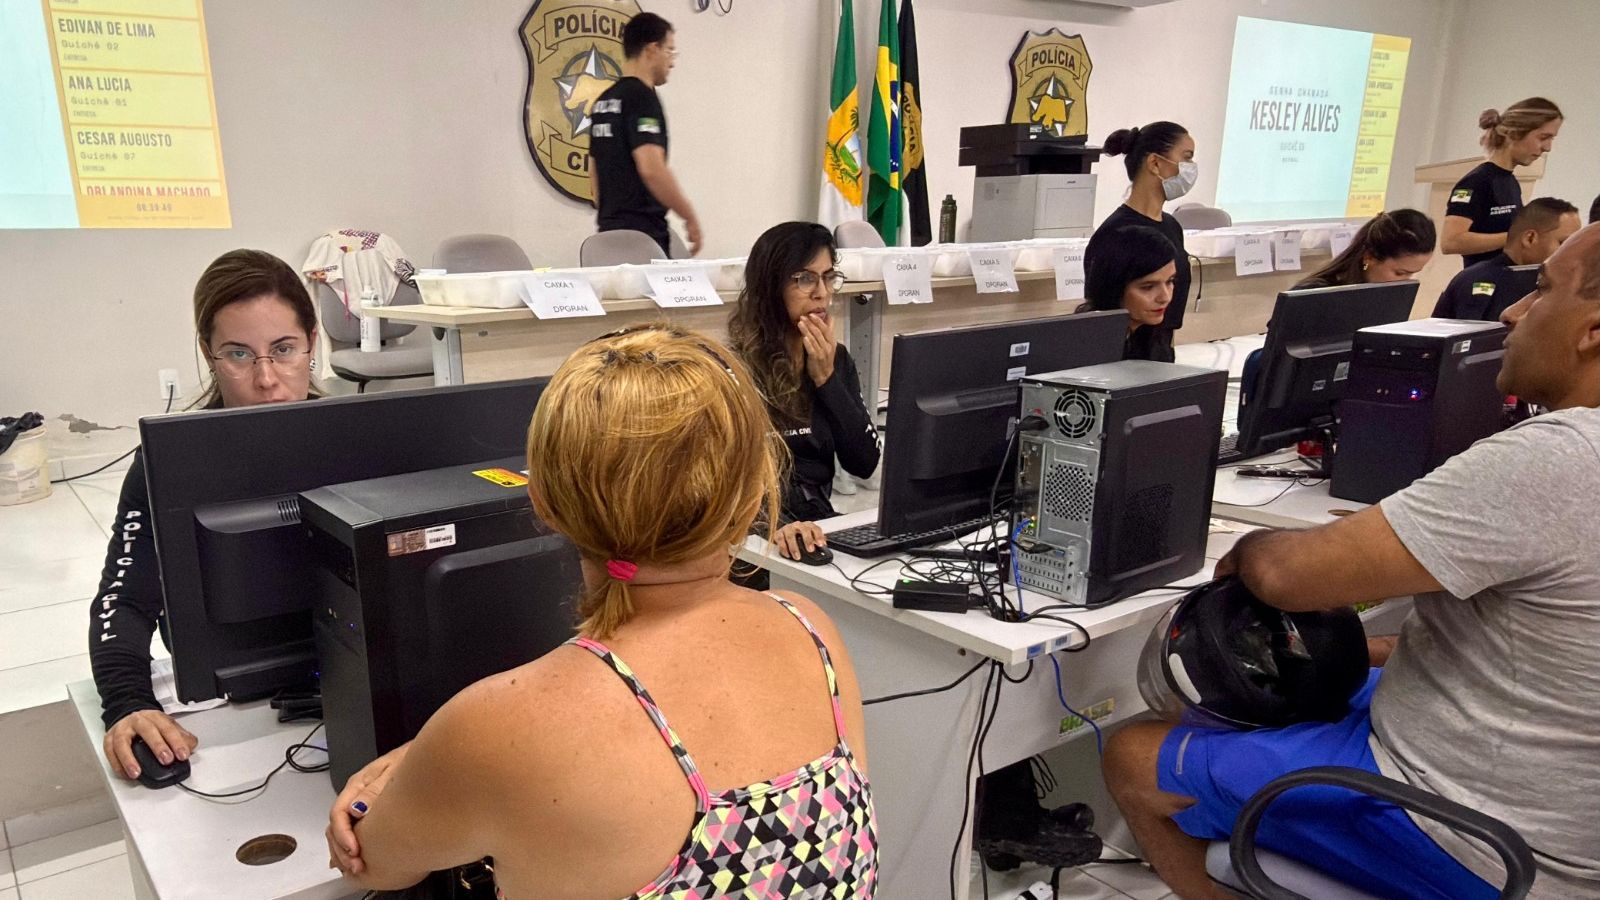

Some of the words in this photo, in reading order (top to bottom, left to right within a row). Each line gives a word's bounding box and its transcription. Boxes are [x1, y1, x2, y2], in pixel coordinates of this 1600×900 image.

[58, 18, 103, 36] EDIVAN
[106, 21, 122, 36] DE
[126, 22, 156, 38] LIMA
[1031, 46, 1075, 71] POLÍCIA
[68, 76, 93, 91] ANA
[97, 77, 132, 92] LUCIA
[1250, 99, 1302, 132] KESLEY
[1301, 102, 1341, 133] ALVES
[77, 131, 116, 146] CESAR
[120, 132, 172, 147] AUGUSTO
[896, 263, 912, 271] CAIXA
[544, 281, 569, 289] CAIXA
[674, 295, 708, 303] DPGRAN
[552, 304, 588, 313] DPGRAN
[108, 510, 142, 589] POLICIA
[98, 593, 118, 642] CIVIL
